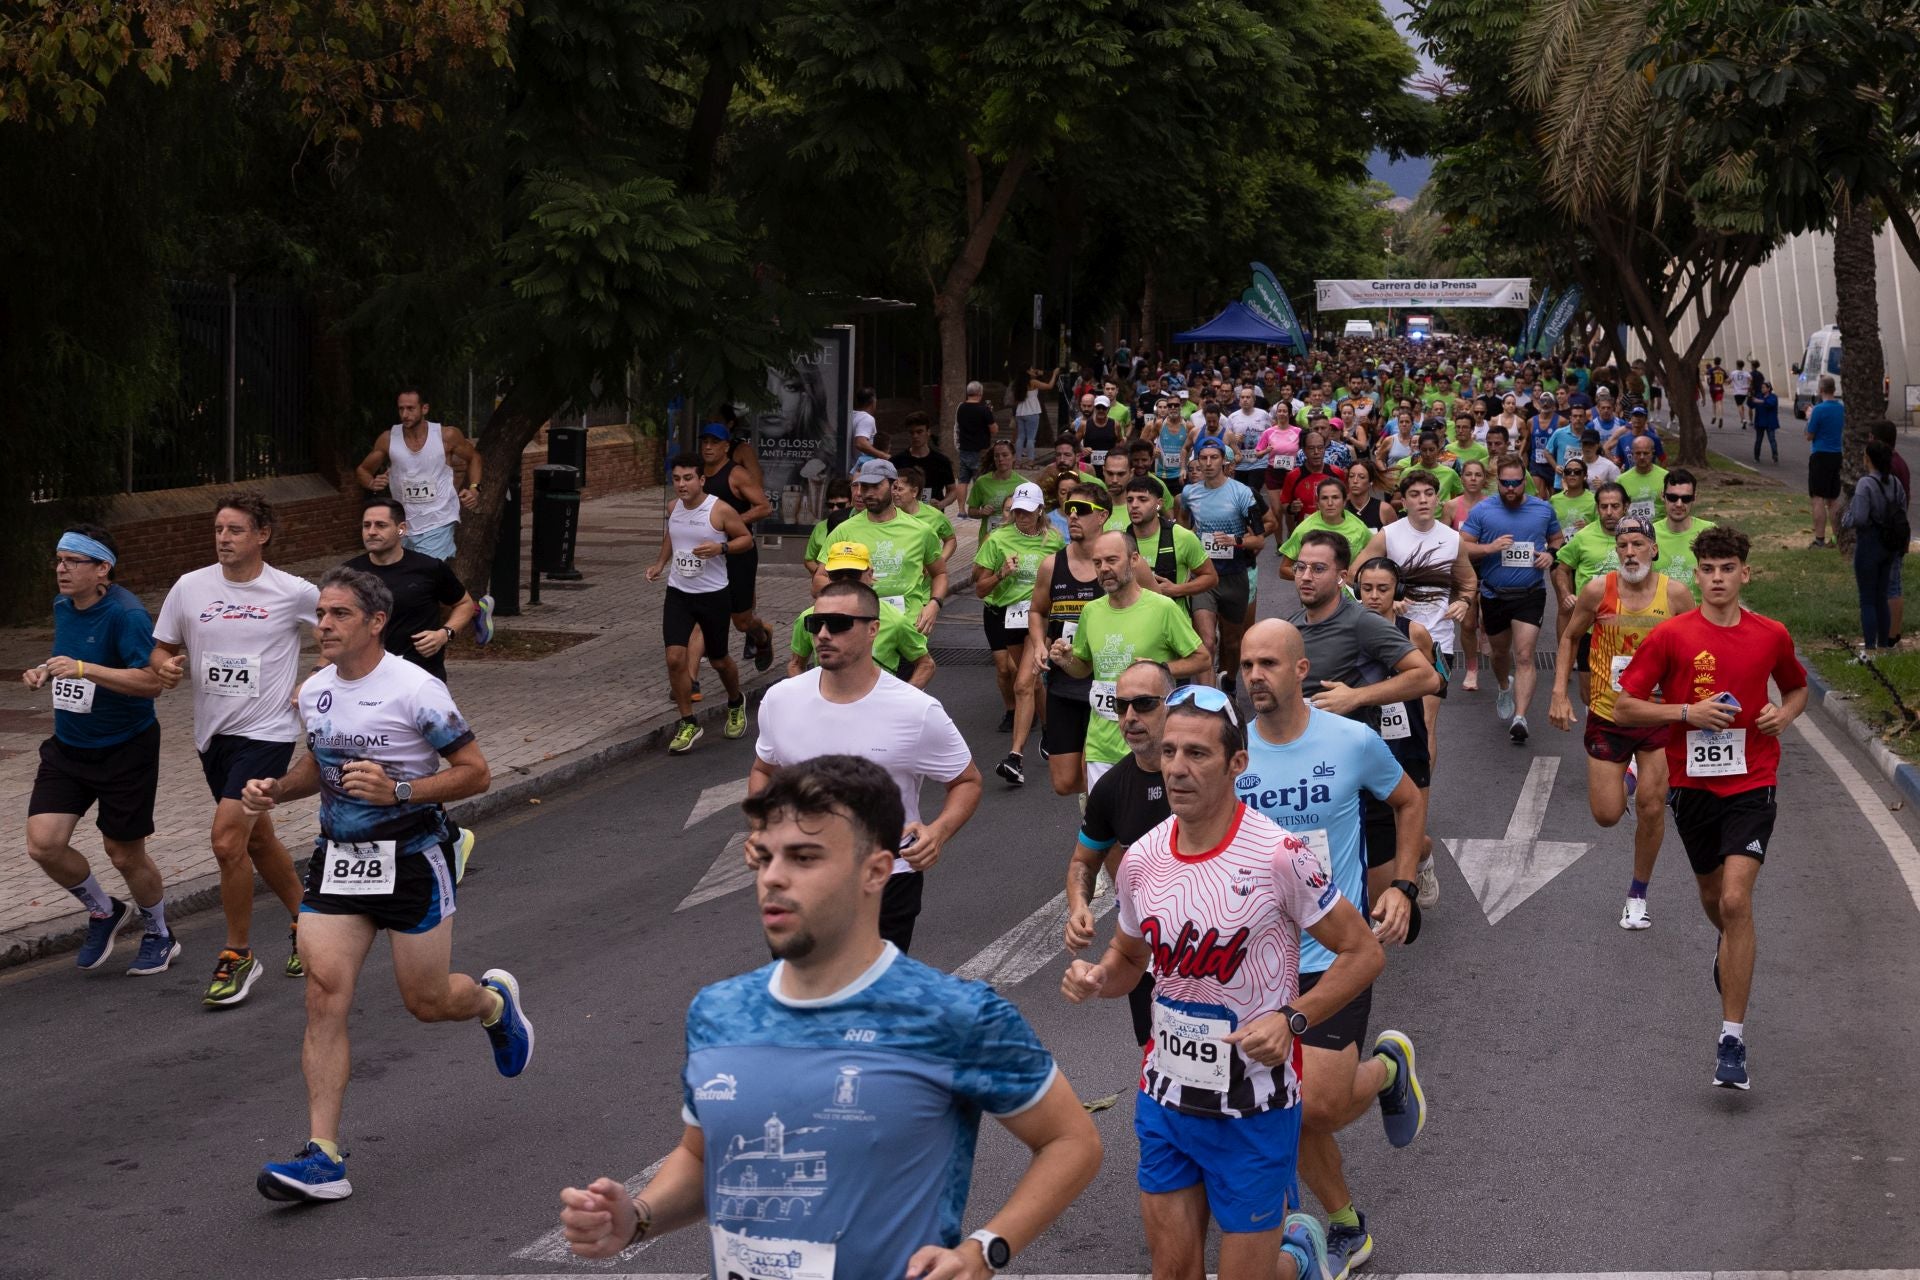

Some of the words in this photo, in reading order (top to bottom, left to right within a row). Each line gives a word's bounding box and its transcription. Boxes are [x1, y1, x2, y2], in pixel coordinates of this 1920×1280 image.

[1371, 281, 1412, 290] Carrera
[1414, 281, 1427, 290] de
[1429, 281, 1440, 290] la
[1441, 281, 1478, 290] Prensa
[1714, 373, 1724, 384] 10
[778, 438, 822, 449] GLOSSY
[762, 450, 812, 459] ANTI-FRIZZ
[406, 487, 429, 496] 171
[1631, 508, 1651, 516] 226
[1204, 541, 1228, 551] 504
[1506, 550, 1530, 559] 308
[676, 558, 702, 568] 1013
[208, 667, 250, 684] 674
[54, 681, 85, 700] 555
[1094, 694, 1116, 709] 78
[1382, 714, 1403, 727] 90
[1694, 744, 1734, 763] 361
[1312, 761, 1337, 775] als
[1239, 778, 1332, 812] nerja
[1275, 813, 1320, 827] ETISMO
[333, 859, 383, 878] 848
[1139, 916, 1248, 984] Wild
[1159, 1029, 1218, 1063] 1049
[695, 1087, 738, 1101] Electrolit
